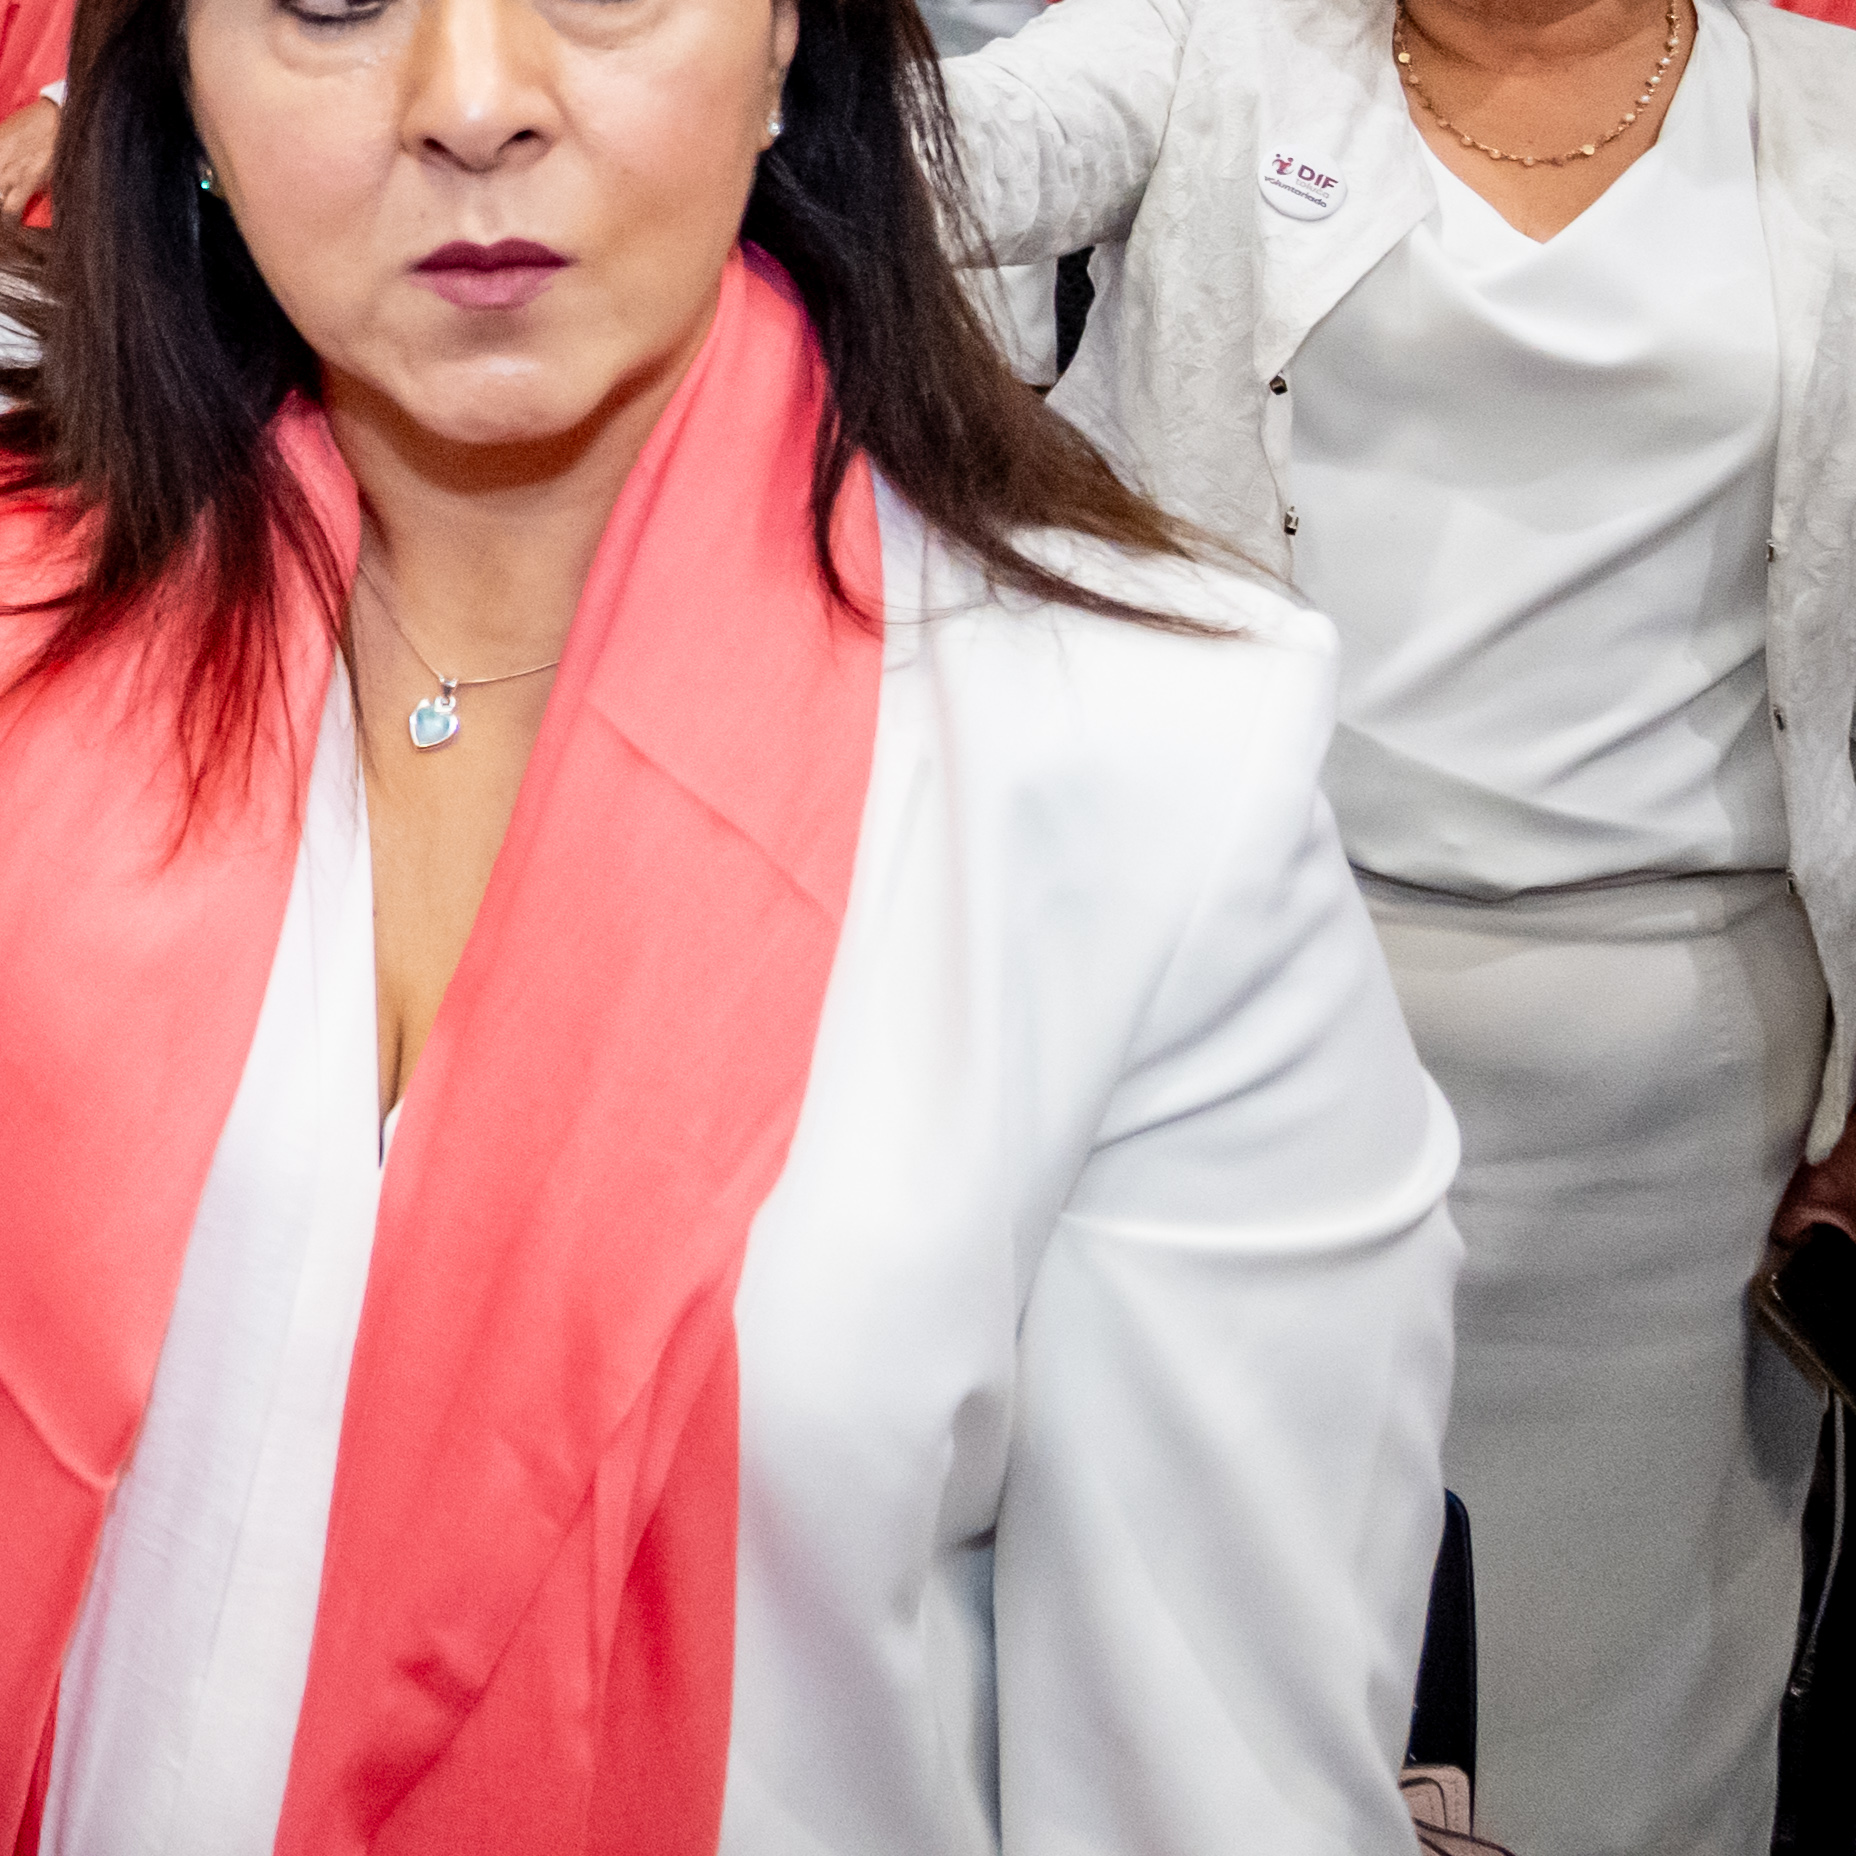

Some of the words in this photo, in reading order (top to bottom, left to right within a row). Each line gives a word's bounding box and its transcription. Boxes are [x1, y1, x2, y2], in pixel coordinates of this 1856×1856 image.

[1296, 178, 1330, 200] toluca
[1297, 164, 1339, 189] DIF
[1264, 176, 1327, 208] voluntariado
